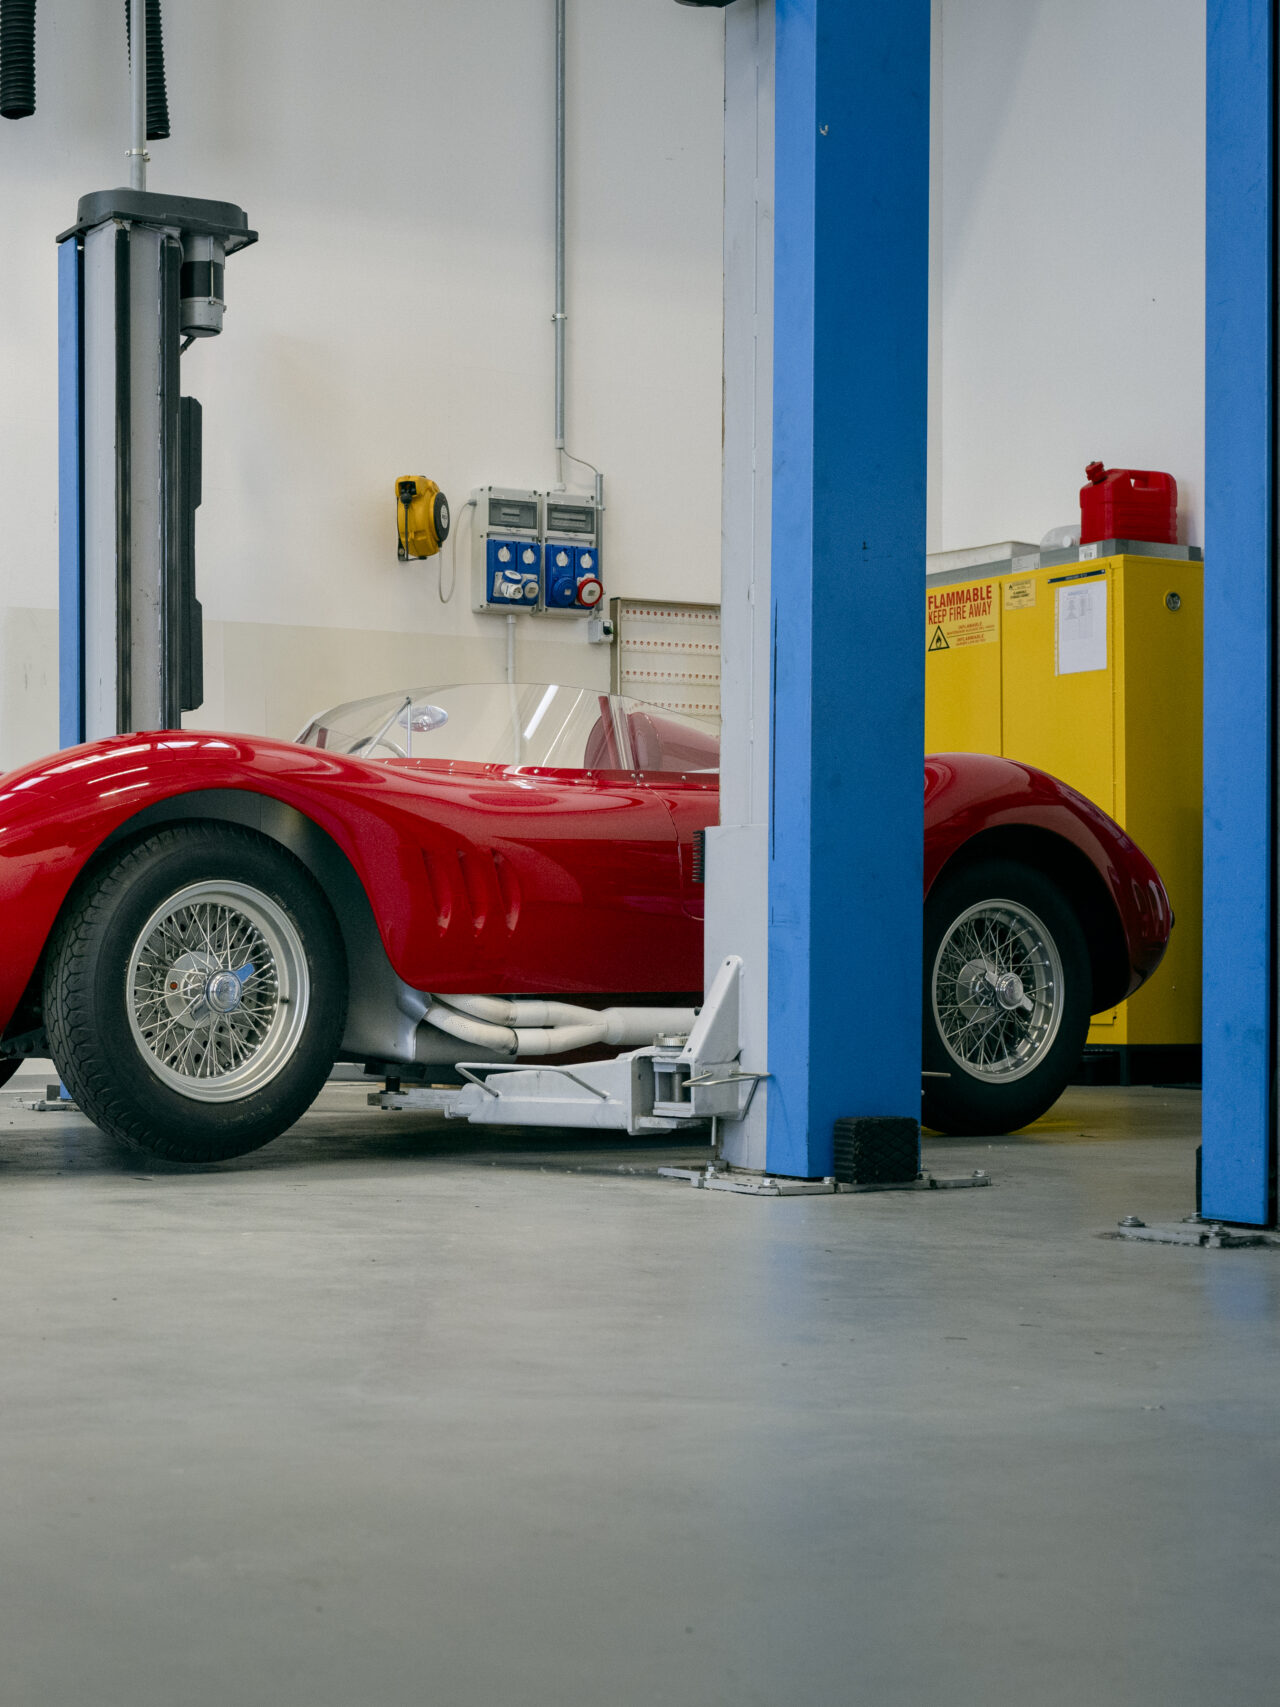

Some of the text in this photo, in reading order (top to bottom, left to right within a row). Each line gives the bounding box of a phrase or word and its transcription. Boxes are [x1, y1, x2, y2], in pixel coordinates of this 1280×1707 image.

[928, 585, 992, 610] FLAMMABLE
[928, 608, 947, 625] KEEP
[949, 605, 966, 621] FIRE
[968, 600, 992, 618] AWAY
